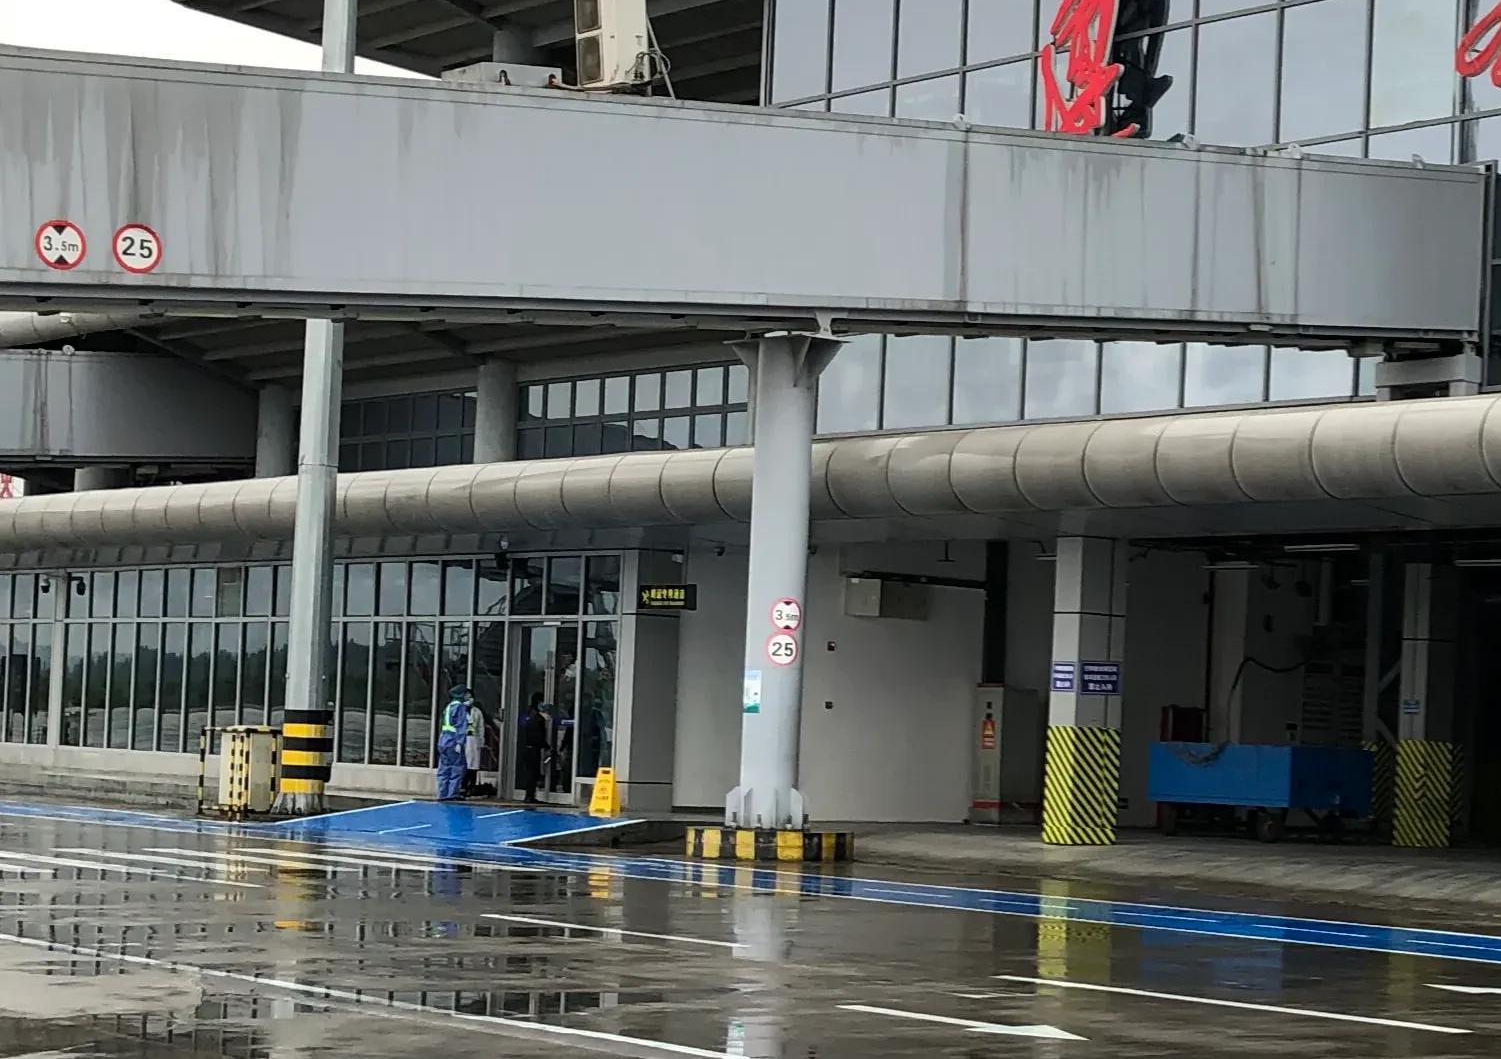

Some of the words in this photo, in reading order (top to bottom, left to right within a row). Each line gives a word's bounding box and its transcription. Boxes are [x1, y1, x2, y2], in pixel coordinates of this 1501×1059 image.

[43, 235, 79, 253] 3.5m
[122, 236, 153, 259] 25
[772, 642, 794, 657] 25
